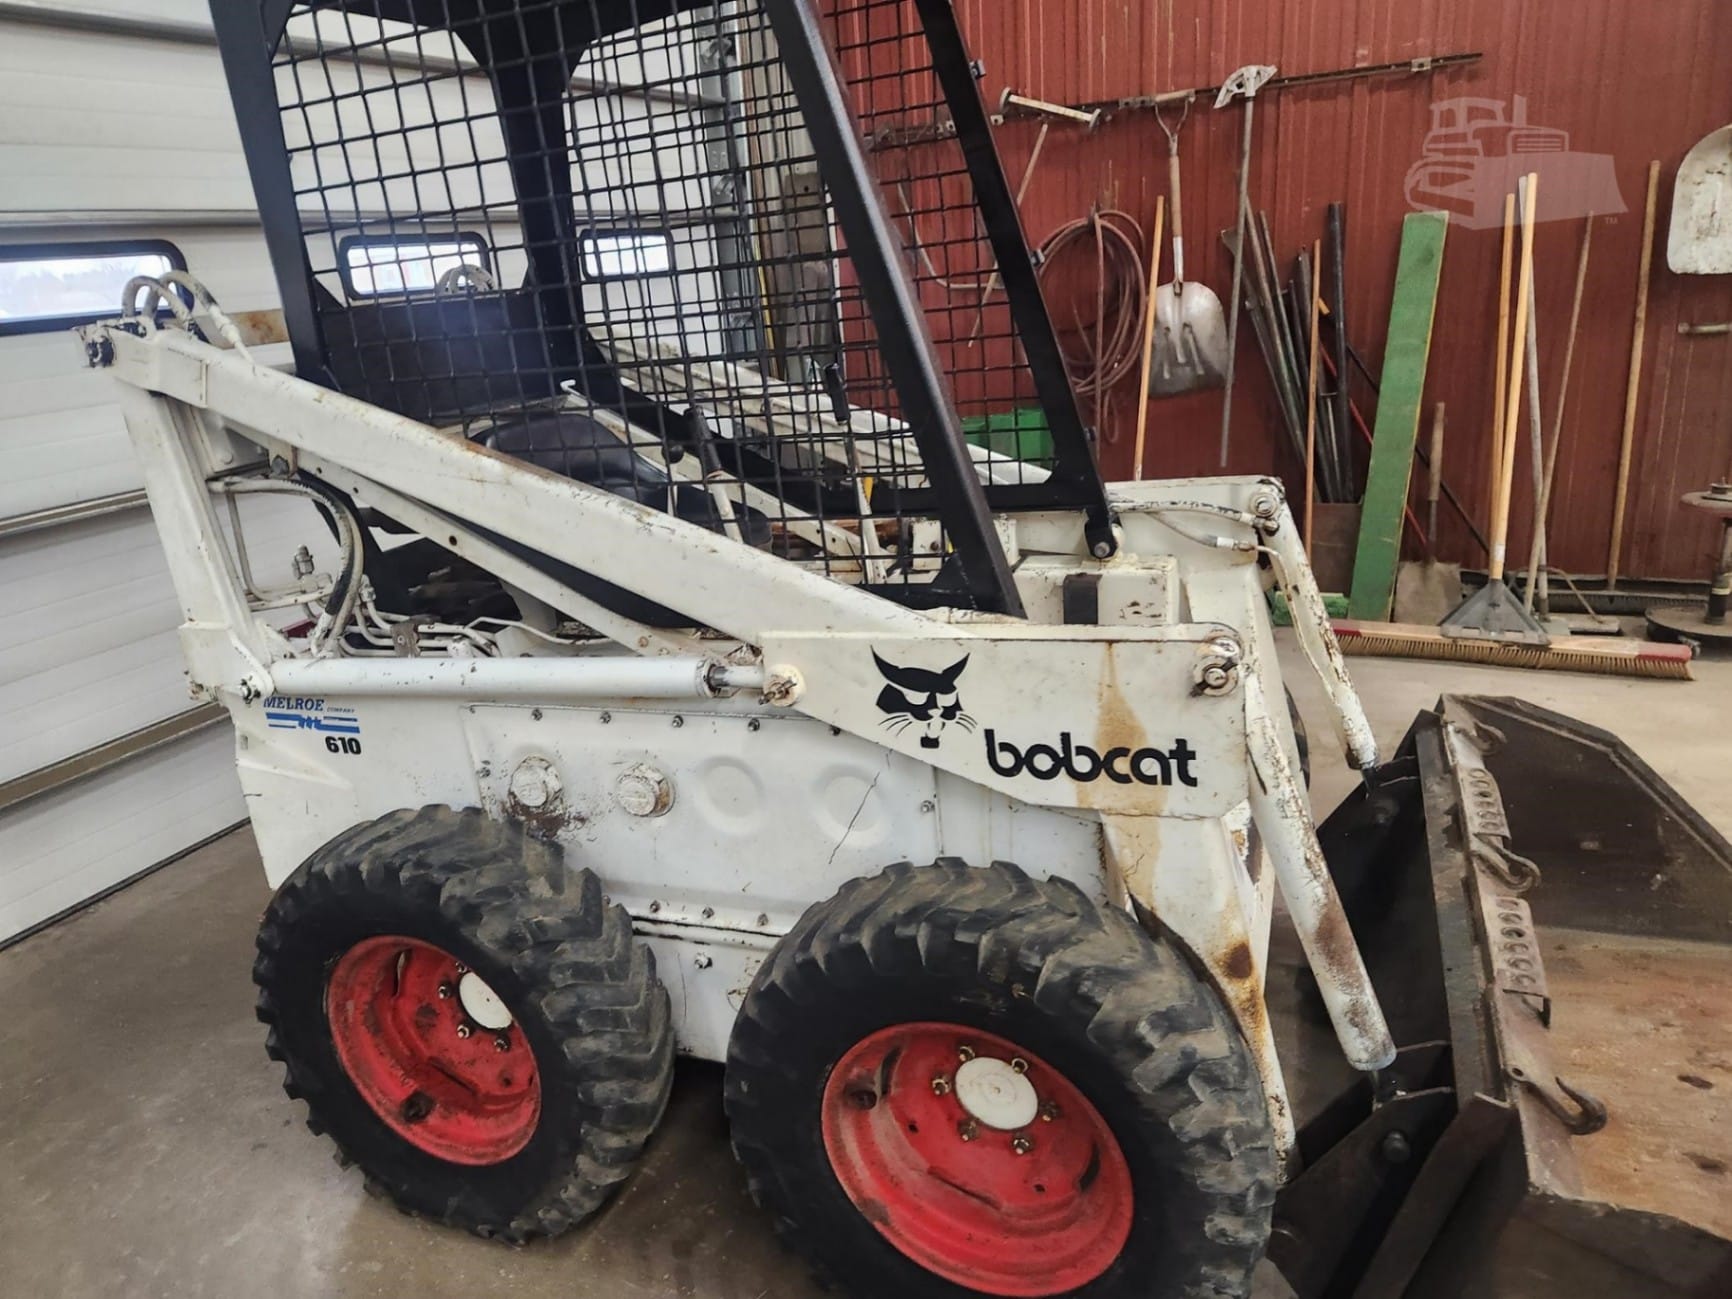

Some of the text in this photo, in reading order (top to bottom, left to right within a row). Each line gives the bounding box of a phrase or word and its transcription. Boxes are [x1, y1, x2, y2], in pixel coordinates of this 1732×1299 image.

[263, 696, 324, 711] MELROE
[325, 736, 361, 755] 610
[984, 729, 1197, 787] bobcat
